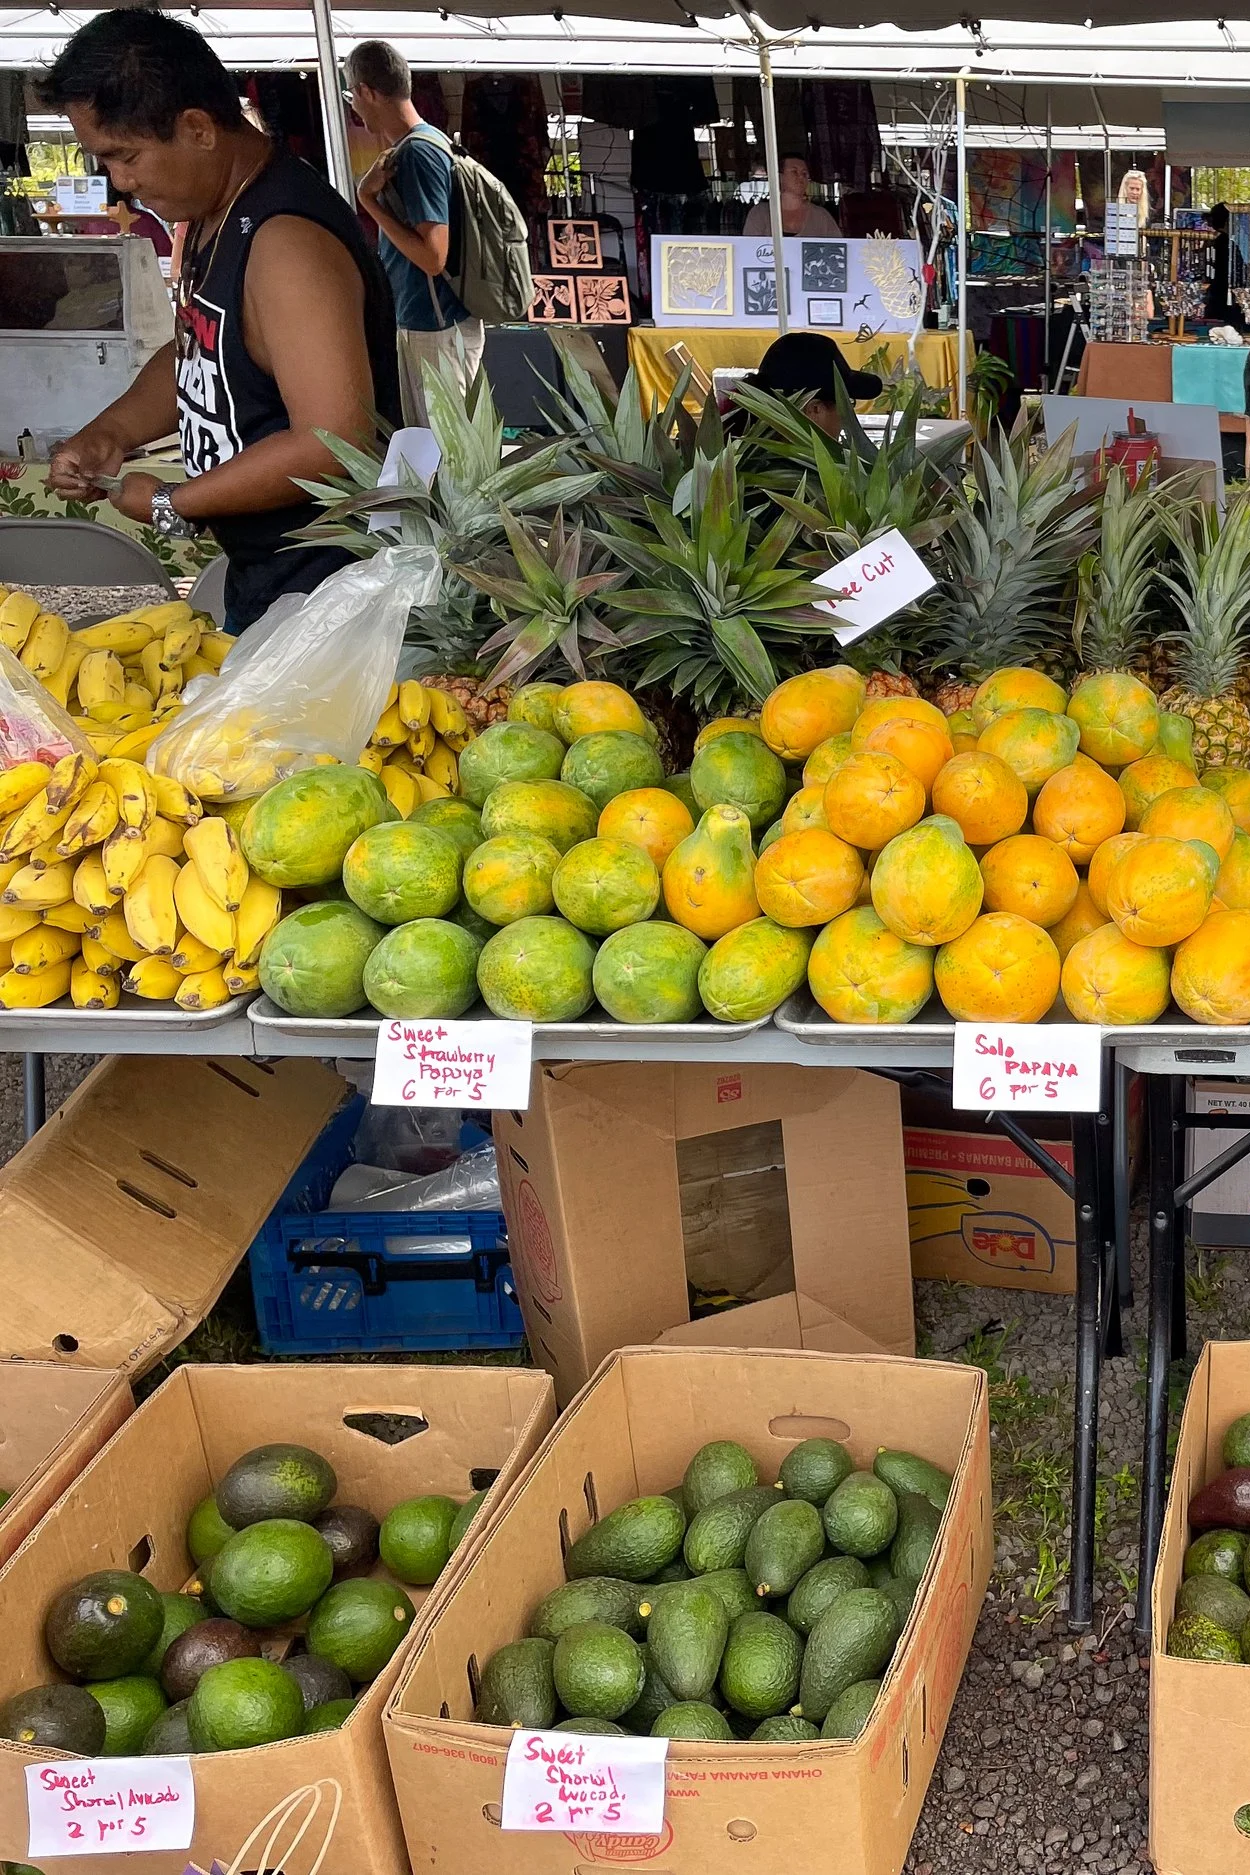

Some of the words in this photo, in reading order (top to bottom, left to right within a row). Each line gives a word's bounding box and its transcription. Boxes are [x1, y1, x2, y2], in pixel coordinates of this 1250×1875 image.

[388, 1022, 448, 1042] Sweet
[975, 1033, 1015, 1058] Solo
[403, 1043, 495, 1072] Strawberry
[1005, 1060, 1078, 1077] PAPAYA
[402, 1079, 416, 1100] 6
[468, 1082, 487, 1101] 5
[979, 1077, 996, 1100] 6
[1044, 1080, 1058, 1098] 5
[905, 1146, 949, 1160] PREMIU
[958, 1152, 1012, 1168] BANANAS
[972, 1231, 1035, 1261] Dole
[710, 1771, 768, 1781] BANANA
[772, 1769, 823, 1781] OHANA
[534, 1802, 555, 1824] 2
[603, 1802, 621, 1821] 5
[67, 1821, 85, 1838] 2
[130, 1816, 147, 1836] 5
[595, 1834, 660, 1850] Candy
